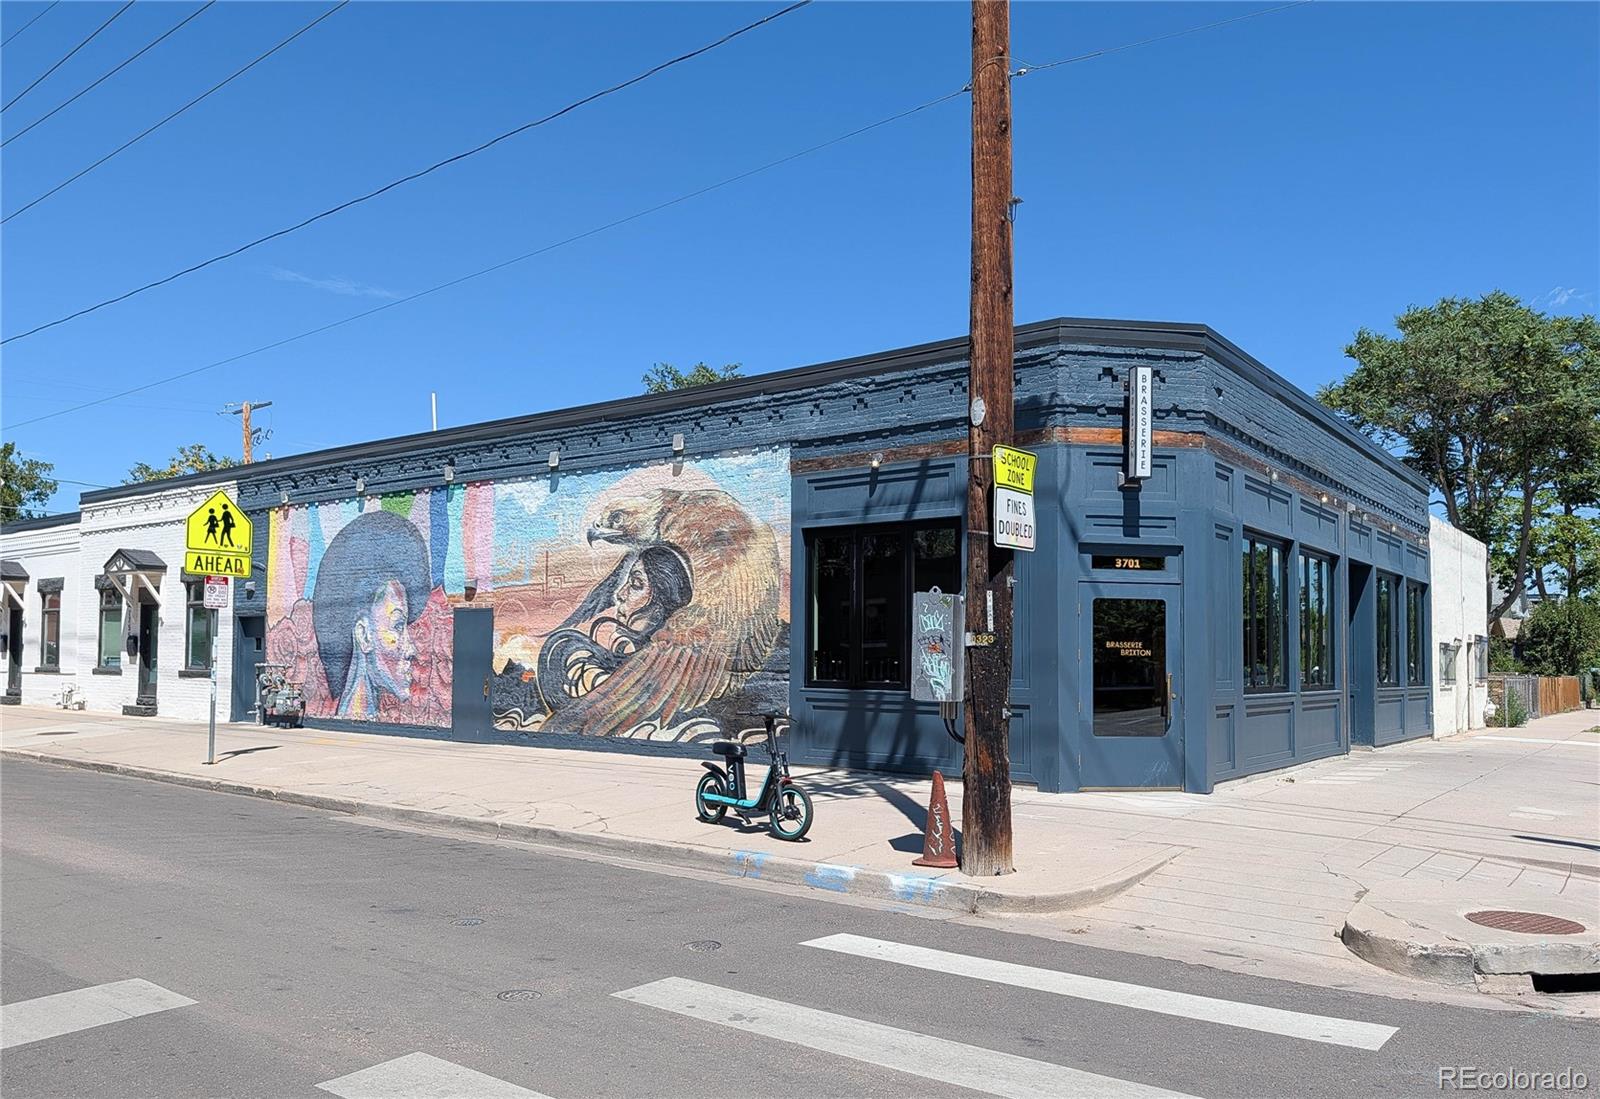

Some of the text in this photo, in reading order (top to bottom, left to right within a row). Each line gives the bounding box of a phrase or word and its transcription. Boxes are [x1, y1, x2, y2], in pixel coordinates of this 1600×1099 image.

[1001, 452, 1030, 471] SCHOOL
[1007, 469, 1025, 486] ZONE
[1007, 498, 1027, 516] FINES
[998, 520, 1033, 539] DOUBLED
[194, 555, 243, 574] AHEAD
[1115, 558, 1140, 568] 3701
[1106, 641, 1143, 649] BRASSERIE
[1120, 649, 1152, 657] BRIXTON
